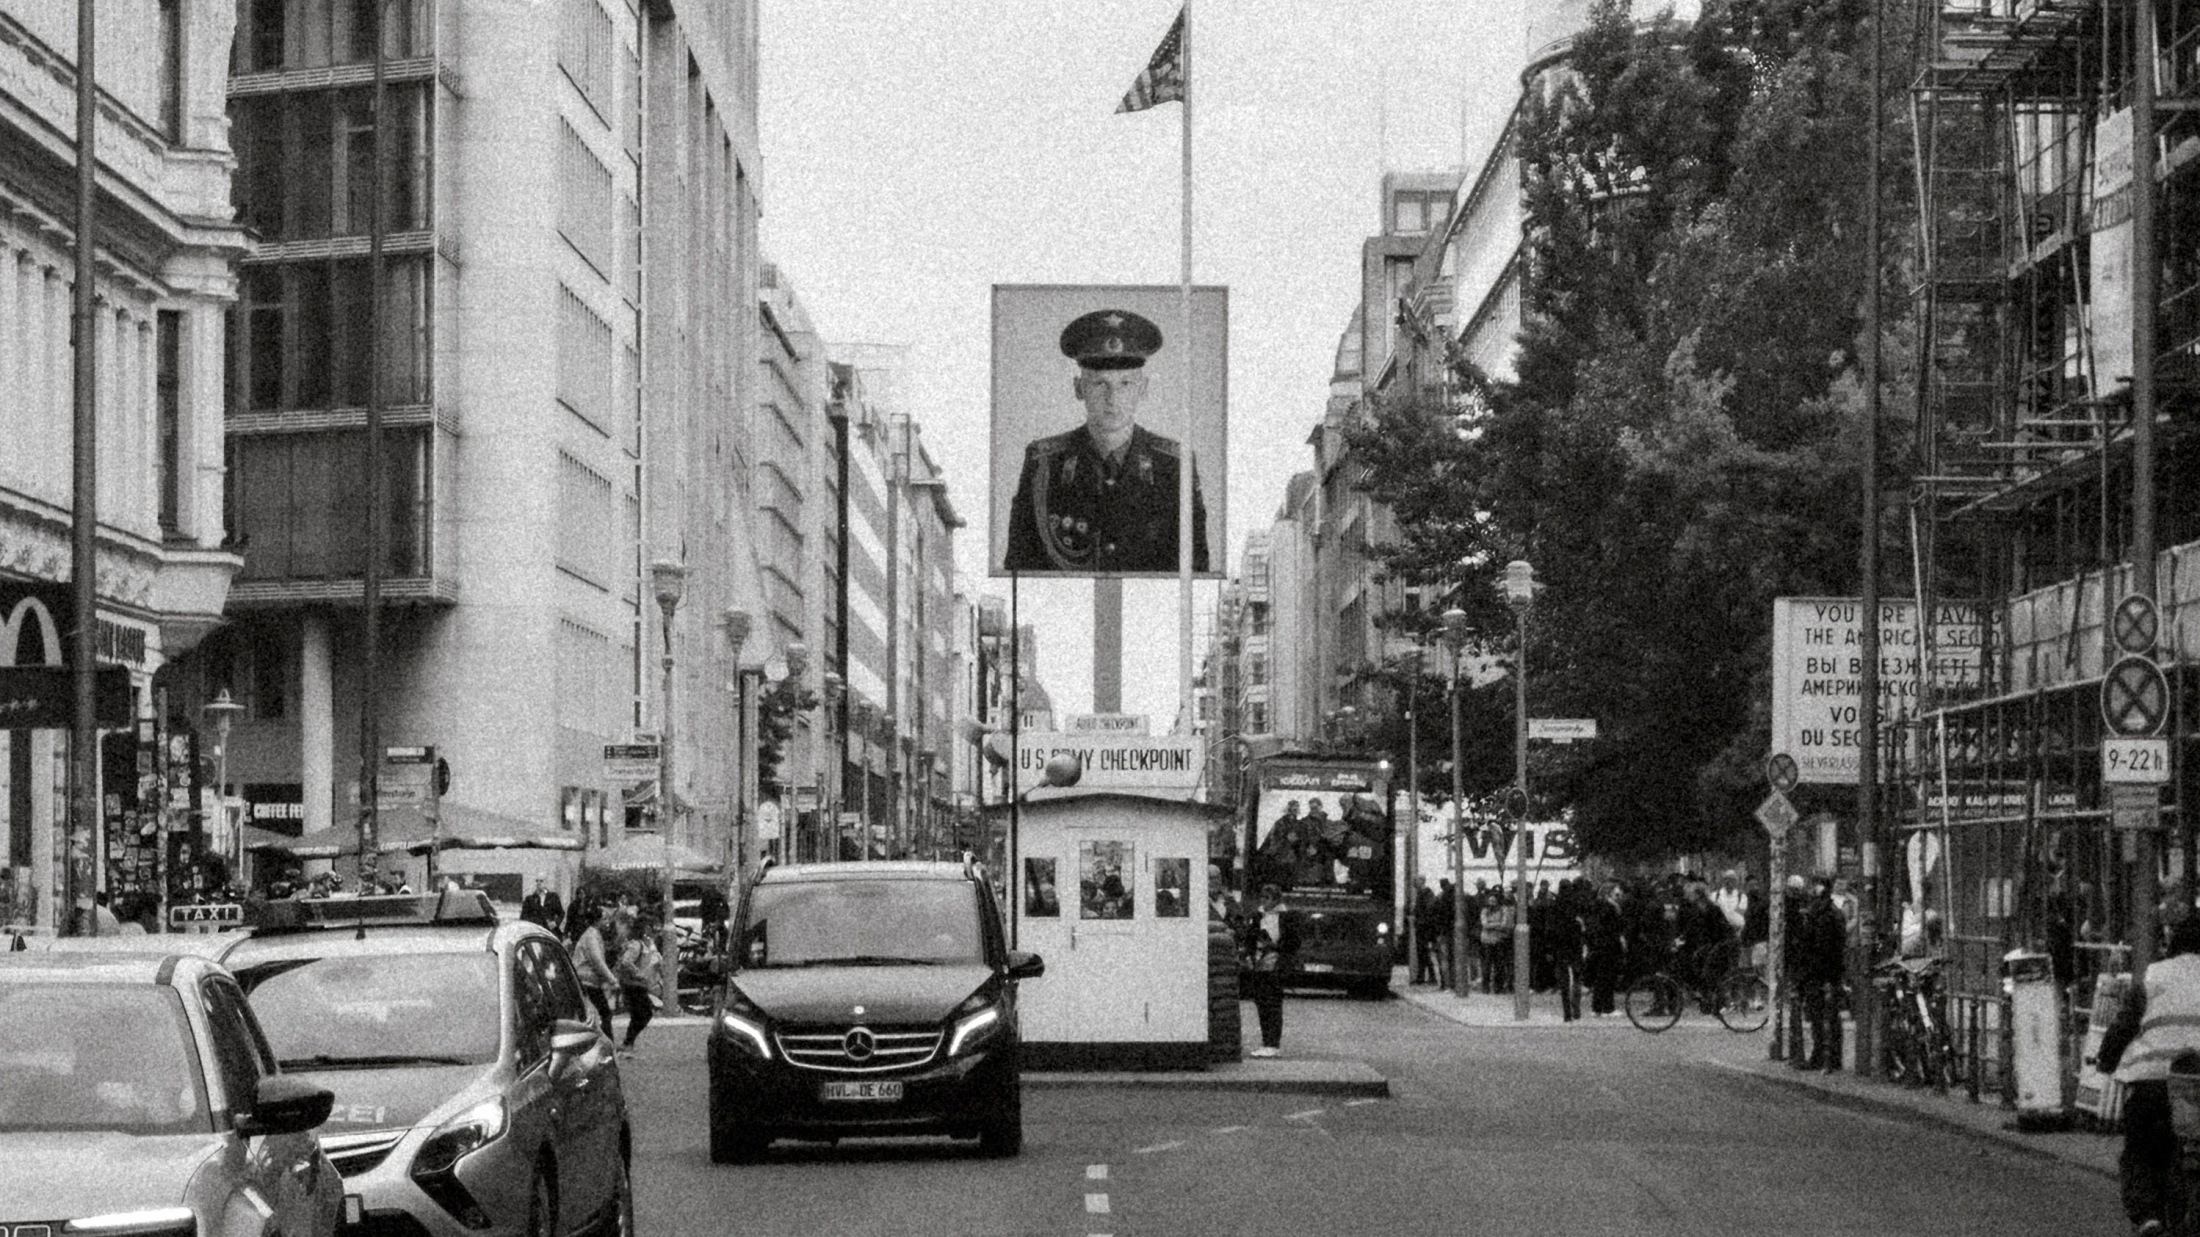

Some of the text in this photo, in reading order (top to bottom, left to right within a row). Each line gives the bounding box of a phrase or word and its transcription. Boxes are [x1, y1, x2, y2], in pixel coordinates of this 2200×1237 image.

[1815, 606, 1854, 623] YOU
[1804, 628, 1833, 645] THE
[1807, 657, 1836, 674] ВЫ
[1830, 706, 1885, 724] VOS
[1802, 729, 1823, 747] DU
[1101, 749, 1192, 771] CHECKPOINT
[2109, 749, 2162, 770] 9-22 h
[253, 802, 288, 819] COFFEE
[181, 906, 229, 922] TAXI
